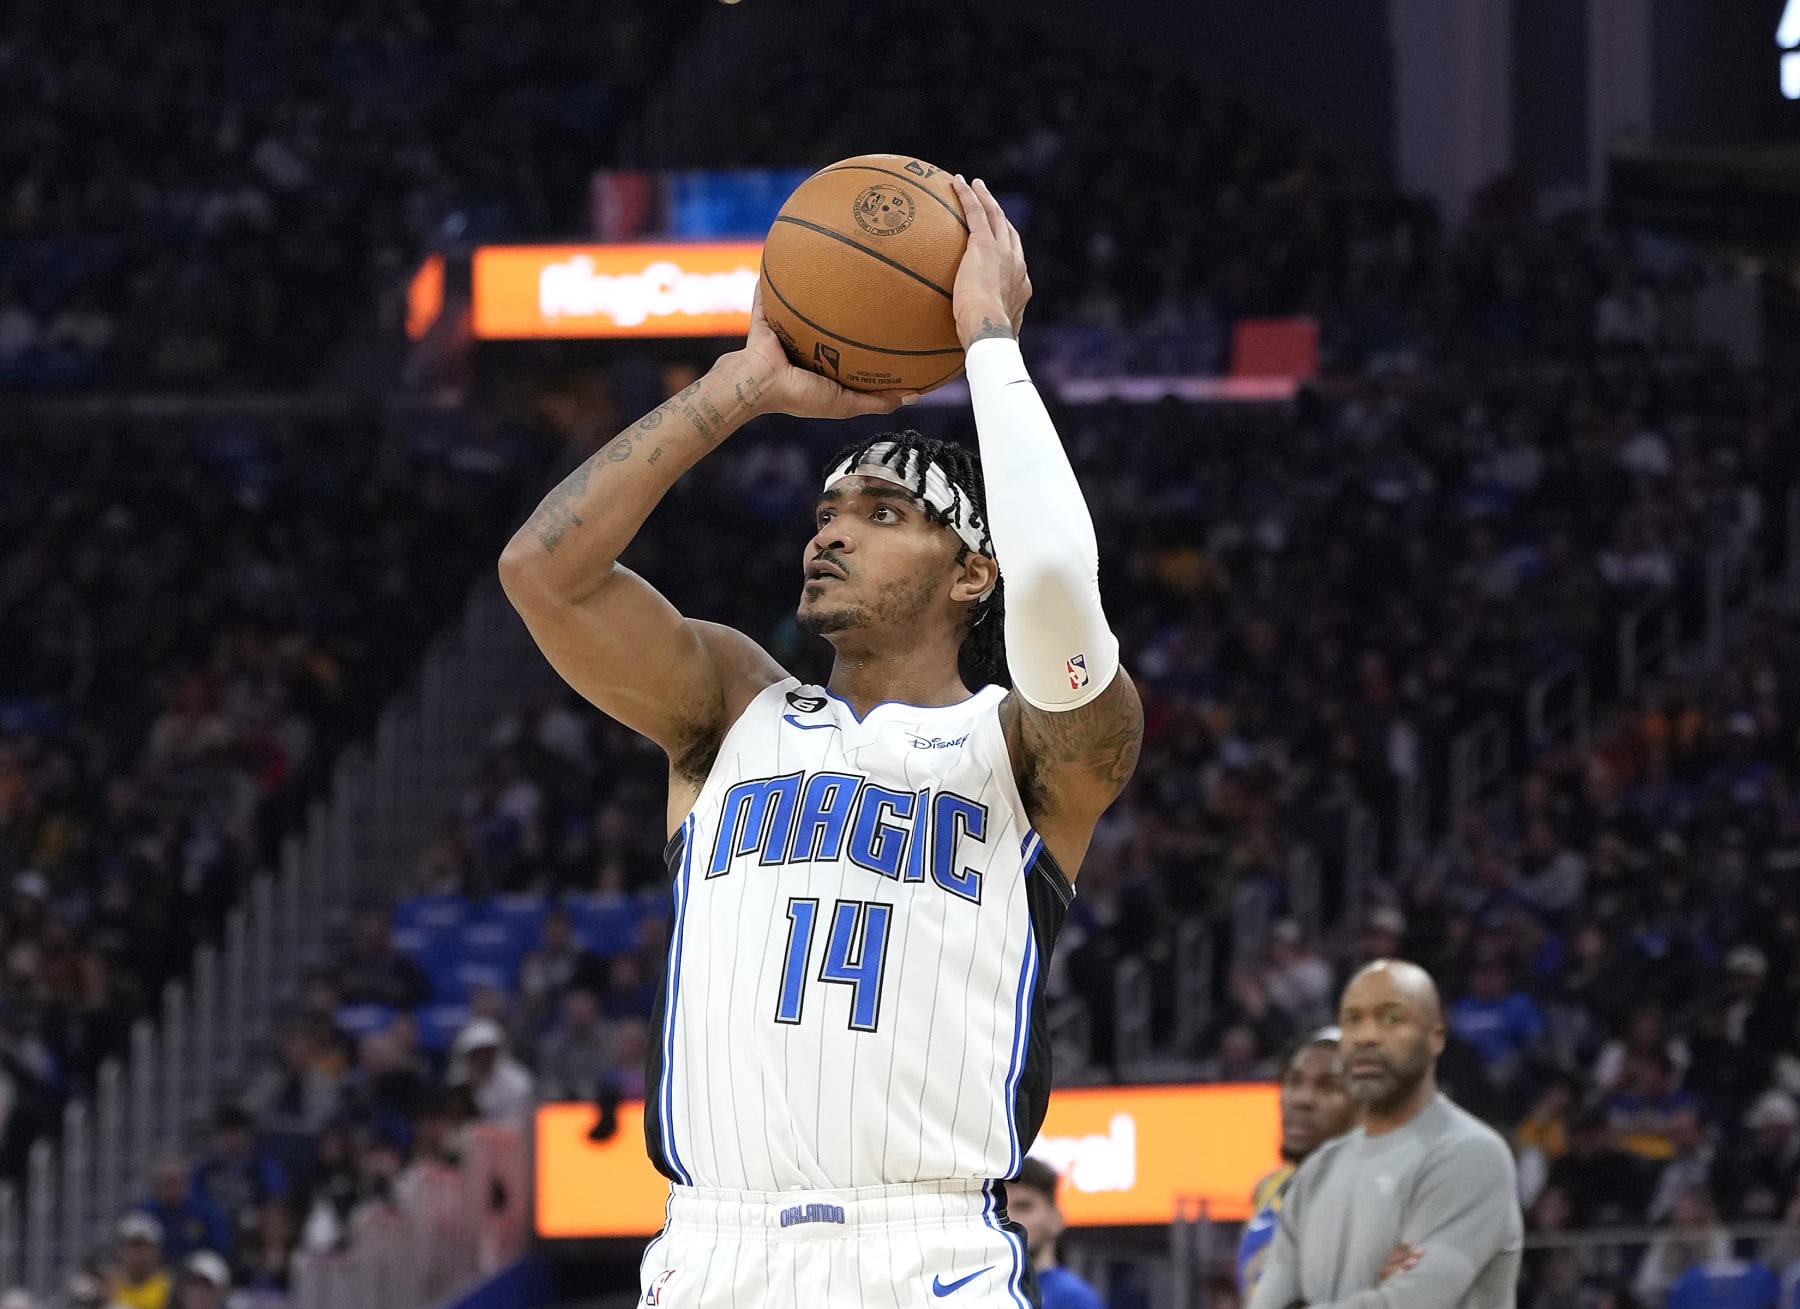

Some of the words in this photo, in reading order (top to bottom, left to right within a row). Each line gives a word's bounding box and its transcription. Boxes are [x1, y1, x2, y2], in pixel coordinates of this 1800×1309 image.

[905, 732, 970, 750] Disney
[705, 770, 988, 906] MAGIC
[774, 897, 894, 1033] 14
[780, 1203, 846, 1228] ORLANDO
